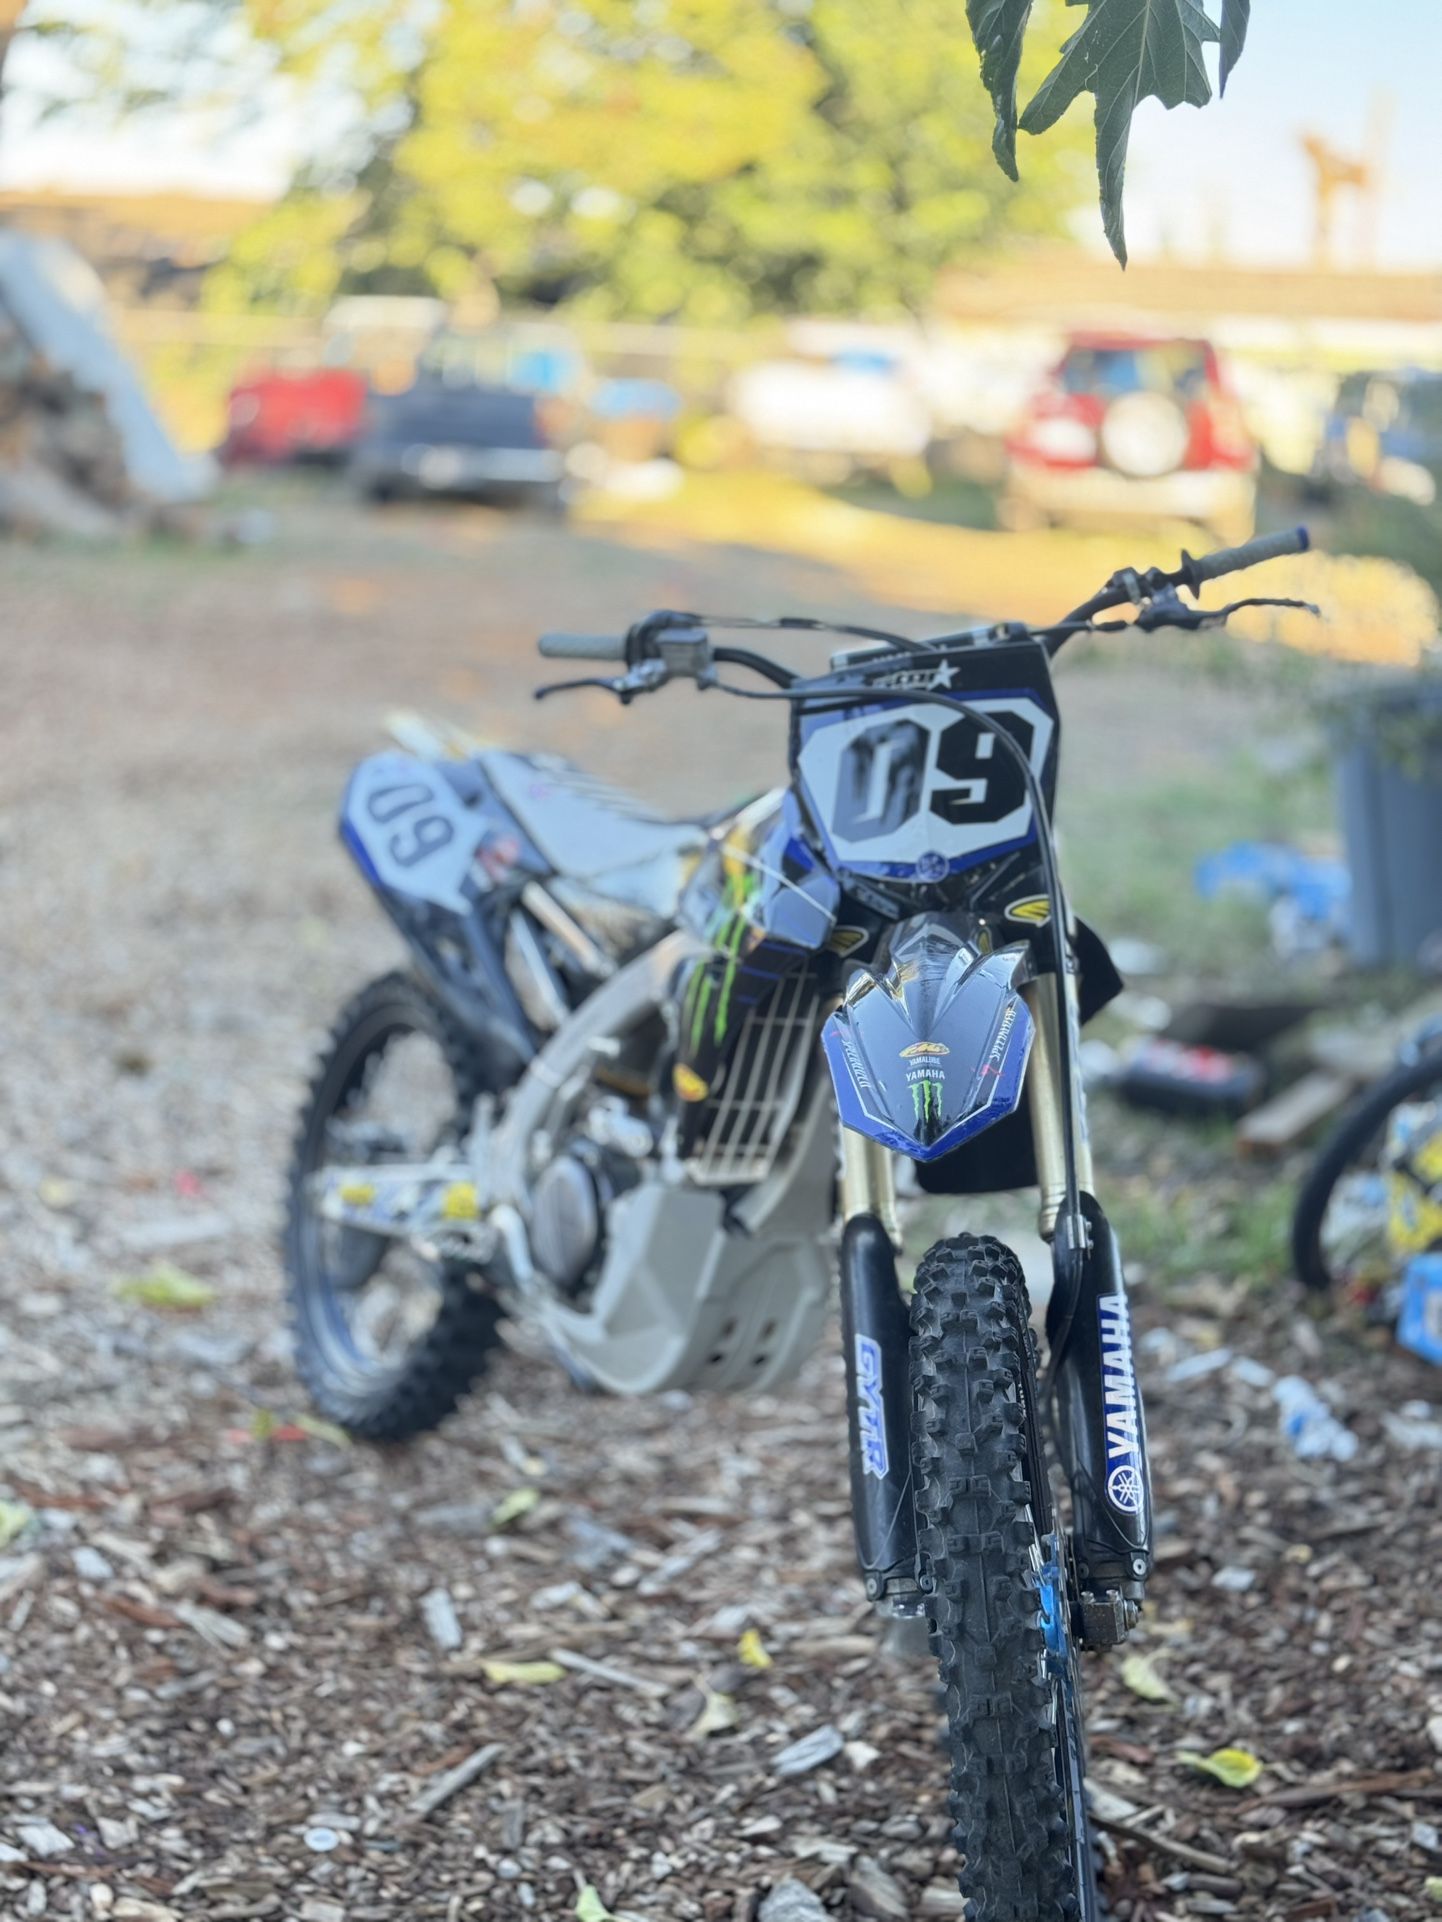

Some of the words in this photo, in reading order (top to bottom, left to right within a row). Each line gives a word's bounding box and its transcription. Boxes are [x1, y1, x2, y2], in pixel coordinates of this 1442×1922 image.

[366, 783, 454, 868] 09
[832, 710, 1035, 843] 09
[905, 1069, 946, 1082] YAMAHA
[854, 1333, 889, 1480] GYTR
[1100, 1294, 1140, 1459] YAMAHA
